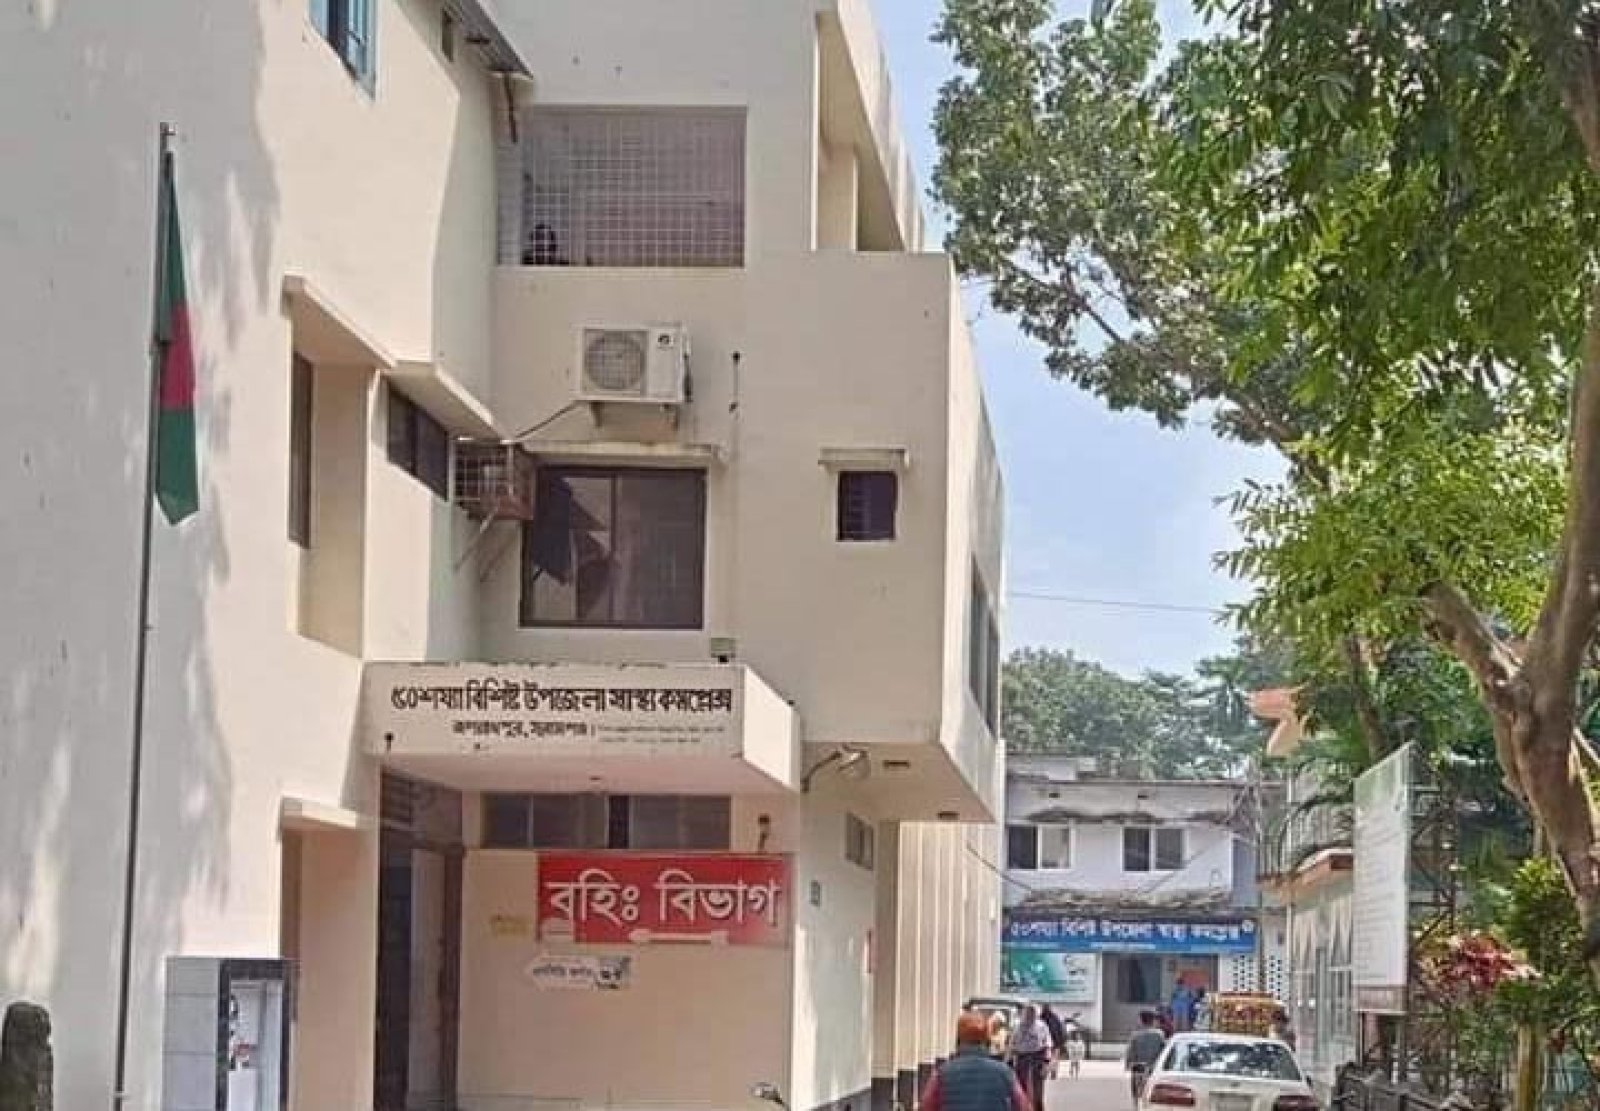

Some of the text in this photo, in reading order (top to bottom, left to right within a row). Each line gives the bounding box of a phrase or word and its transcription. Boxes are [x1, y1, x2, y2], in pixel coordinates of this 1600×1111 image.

[523, 678, 605, 711] উপজেলা
[545, 866, 783, 929] বহিঃ বিভাগ
